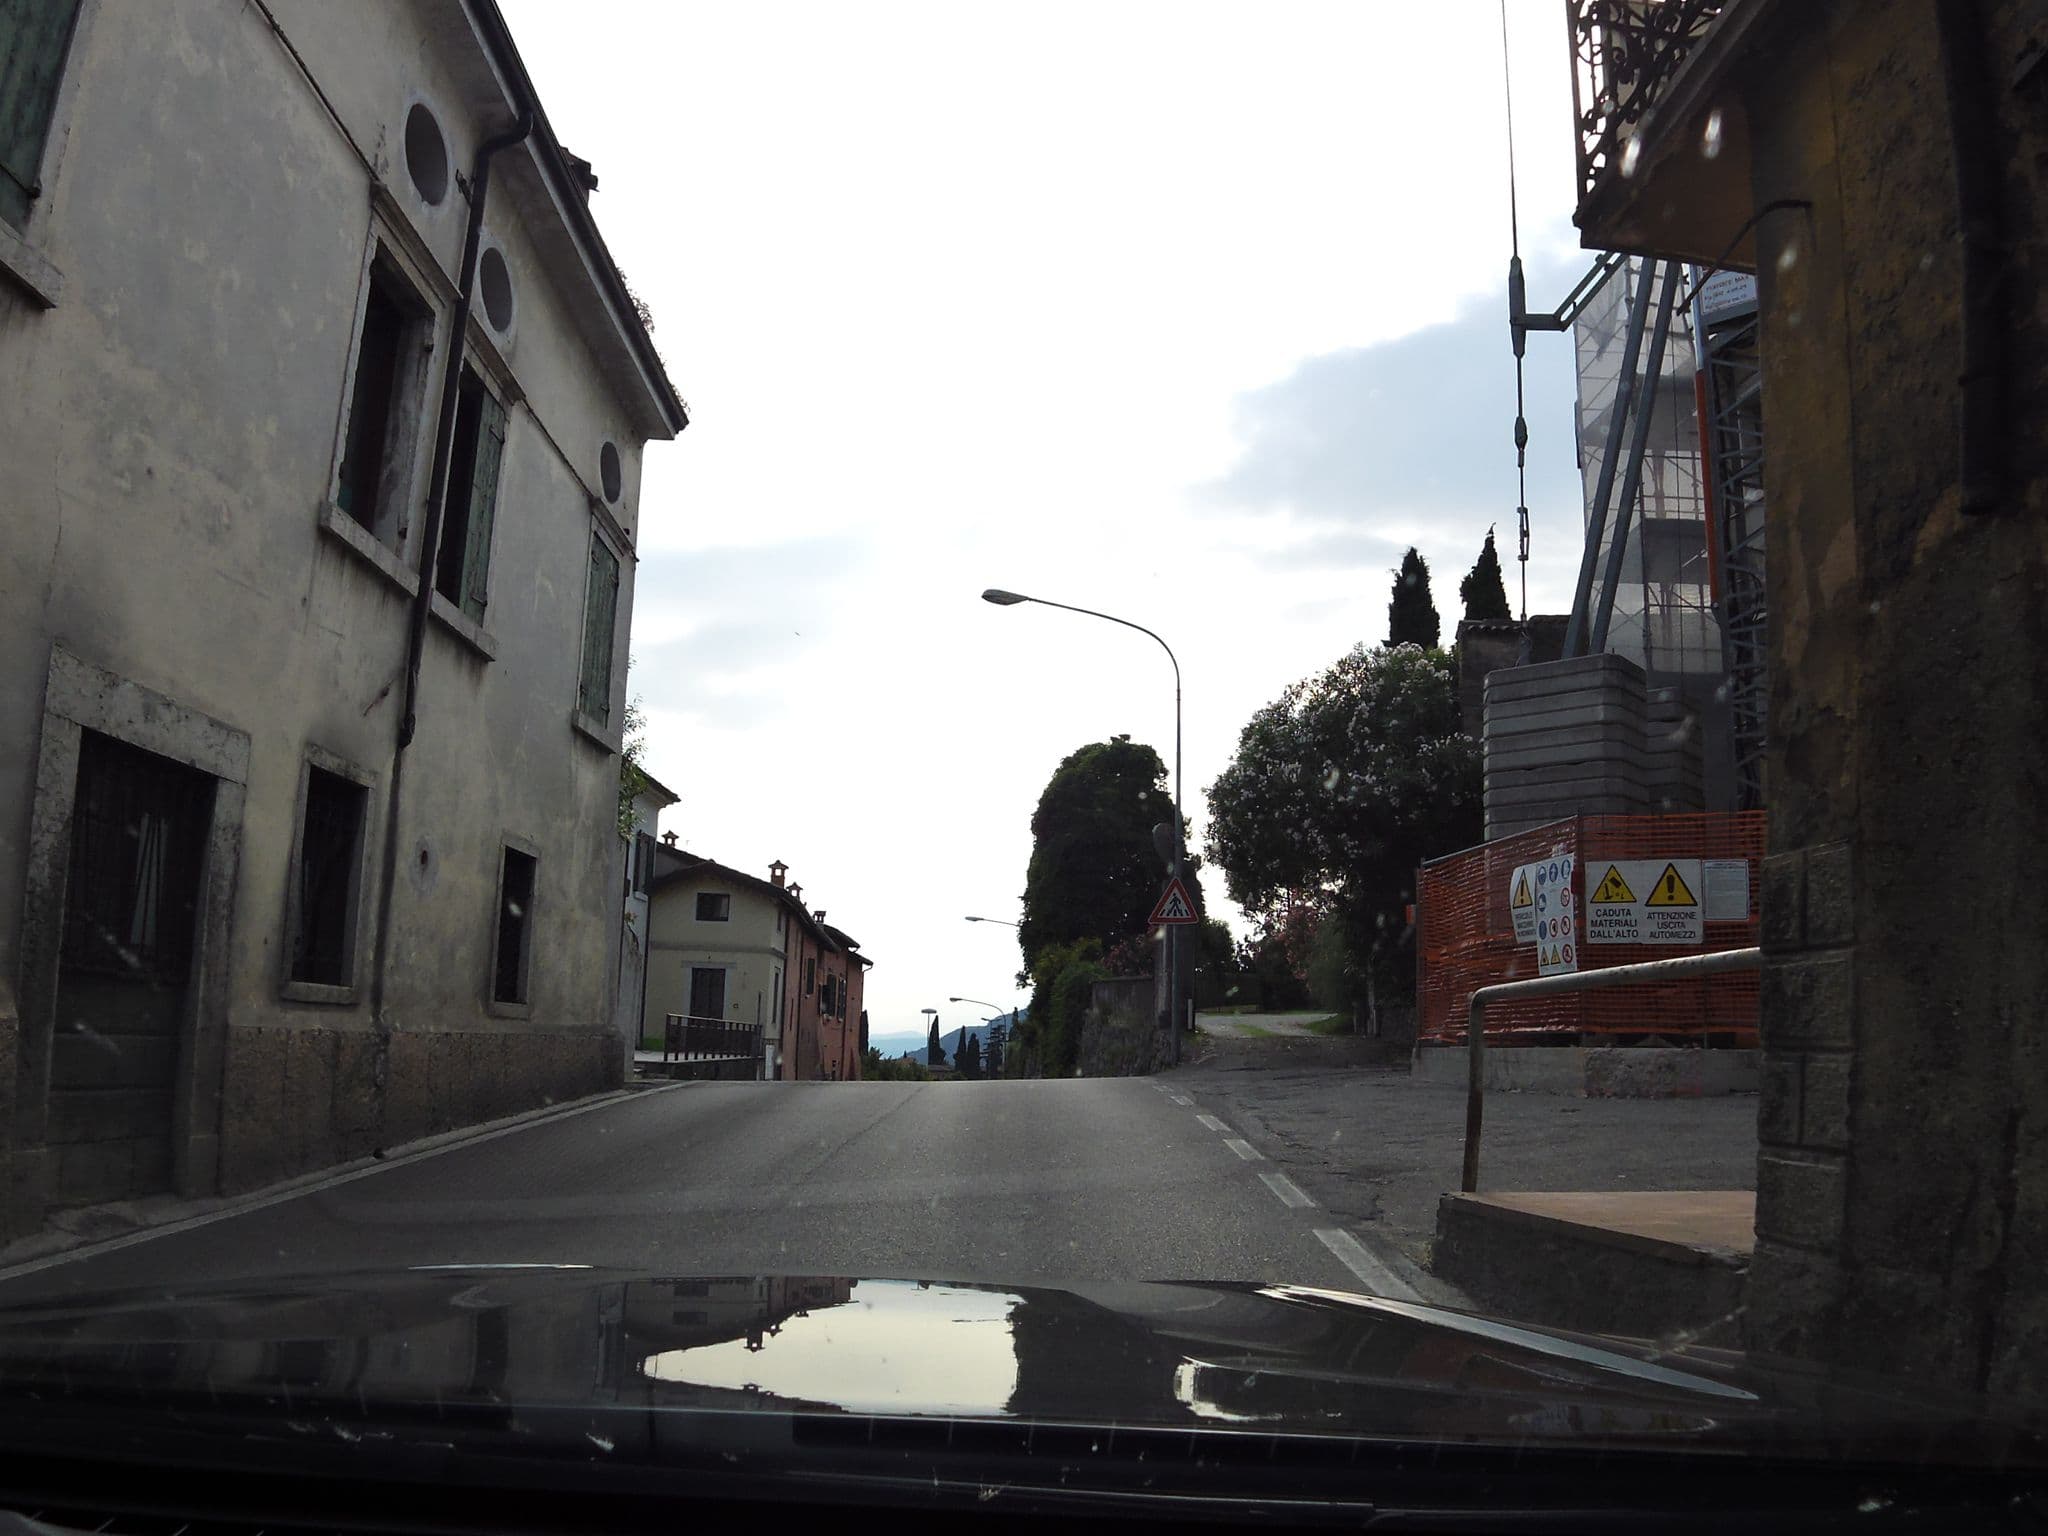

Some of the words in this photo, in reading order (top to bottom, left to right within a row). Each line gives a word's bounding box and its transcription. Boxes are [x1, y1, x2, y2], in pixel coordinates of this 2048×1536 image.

[1596, 908, 1632, 917] CADUTA
[1646, 911, 1697, 920] ATTENZIONE
[1590, 919, 1637, 928] MATERIALI
[1656, 921, 1686, 930] USCITA
[1590, 929, 1639, 939] DALL'ALTO
[1649, 930, 1696, 939] AUTOMEZZI
